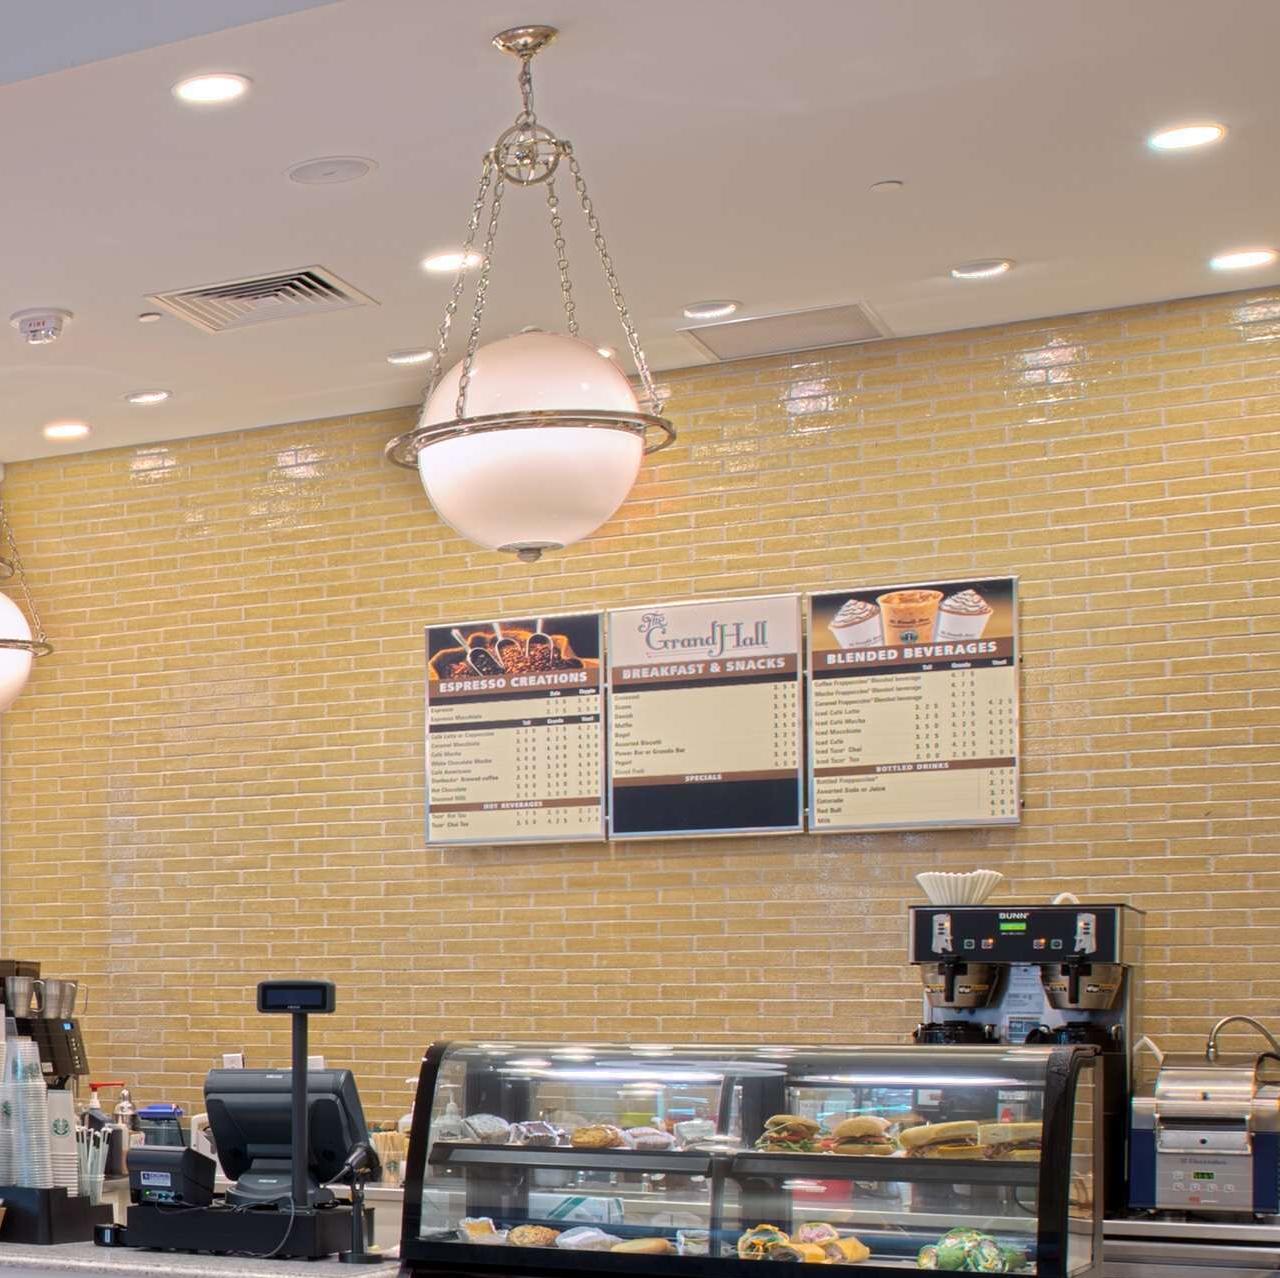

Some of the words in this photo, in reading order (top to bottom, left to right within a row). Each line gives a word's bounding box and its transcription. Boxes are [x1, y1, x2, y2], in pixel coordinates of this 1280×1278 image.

[638, 611, 668, 633] The
[645, 621, 718, 650] Grand
[707, 620, 769, 658] Hall
[826, 648, 898, 665] BLENDED
[903, 641, 998, 659] BEVERAGES
[622, 663, 706, 680] BREAKFAST
[710, 662, 721, 673] &
[725, 657, 786, 672] SNACKS
[439, 678, 507, 693] ESPRESSO
[510, 672, 588, 687] CREATIONS
[684, 773, 722, 783] SPECIALS
[875, 763, 913, 773] BOTTLED
[916, 762, 950, 771] DRINKS
[501, 801, 544, 809] BEVERAGES
[999, 912, 1027, 920] BUNN
